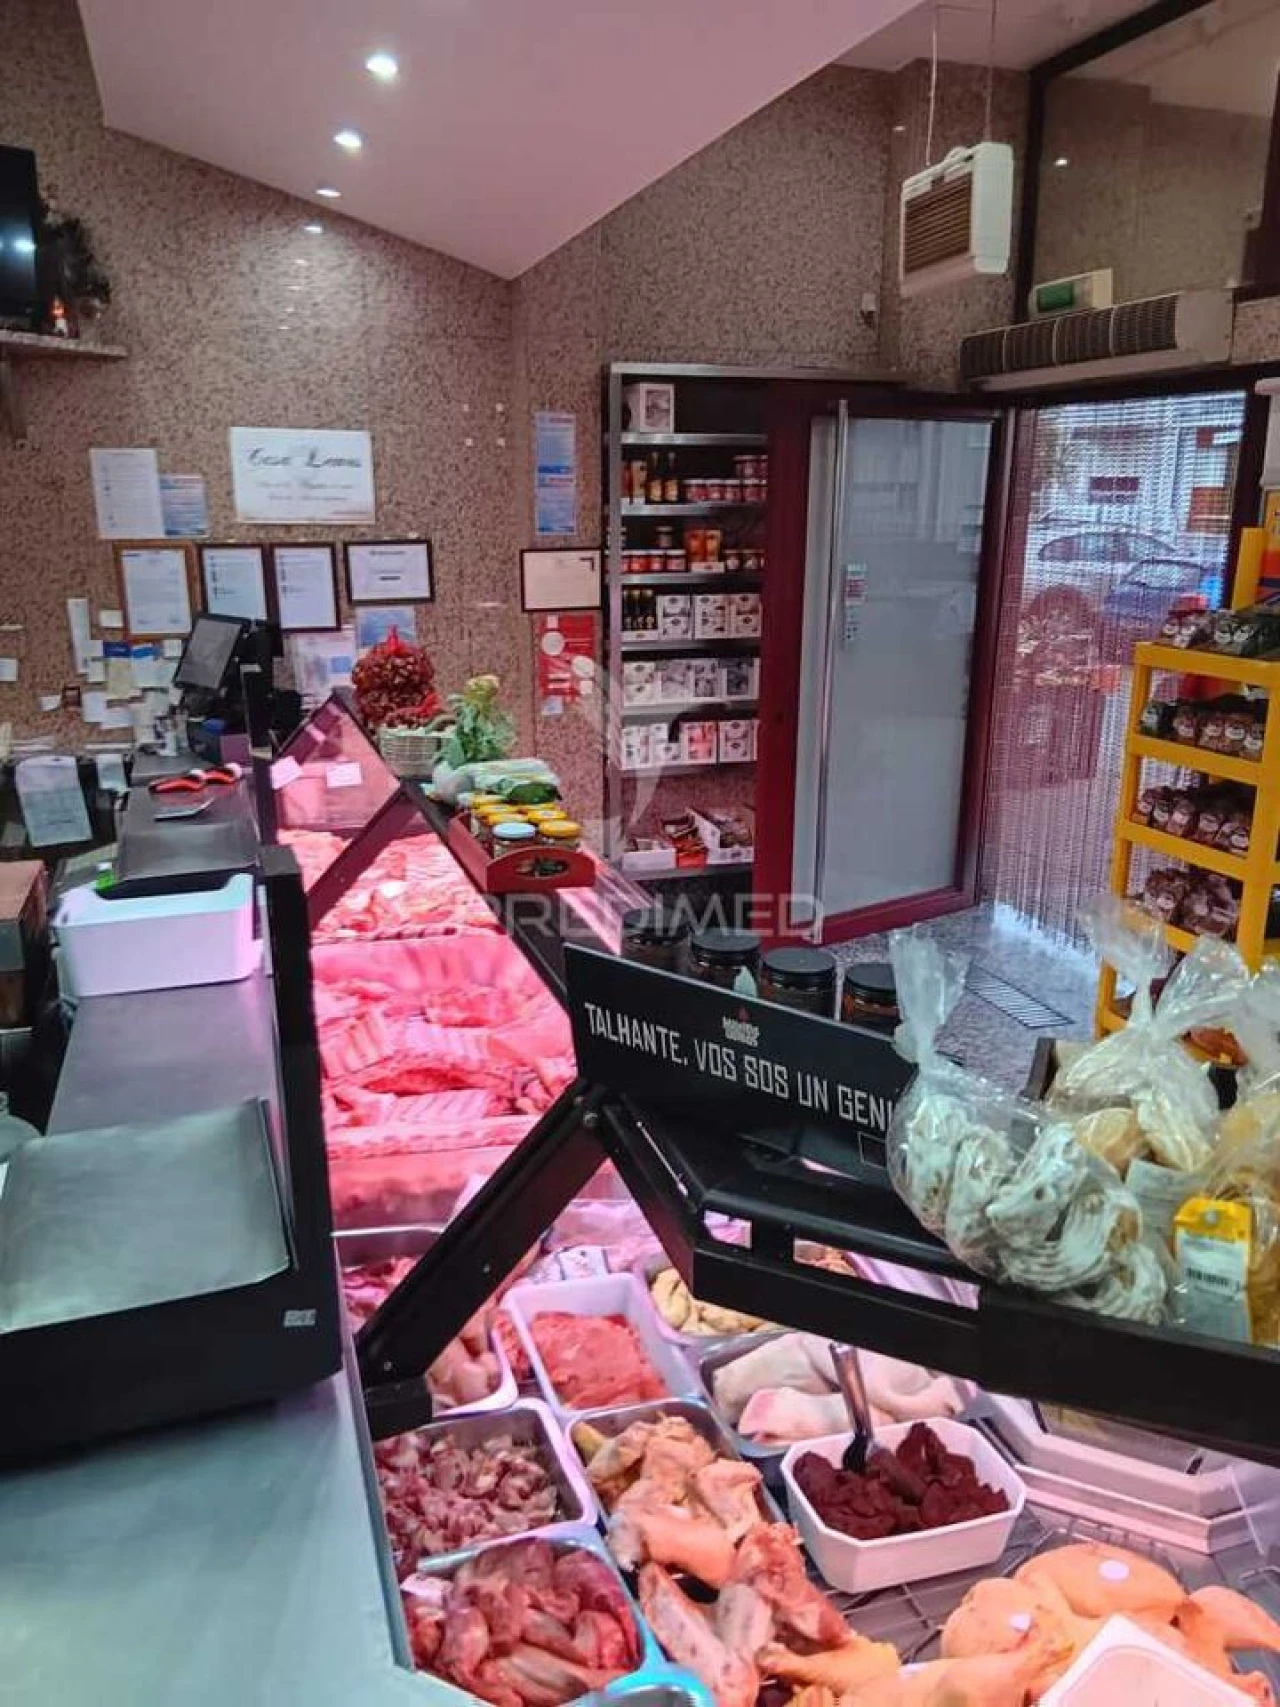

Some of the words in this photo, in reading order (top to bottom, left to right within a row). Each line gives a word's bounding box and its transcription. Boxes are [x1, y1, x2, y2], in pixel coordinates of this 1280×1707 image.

[694, 1039, 737, 1082] VOS
[744, 1054, 790, 1099] SOS
[797, 1071, 830, 1113] UN
[837, 1084, 894, 1132] GENI
